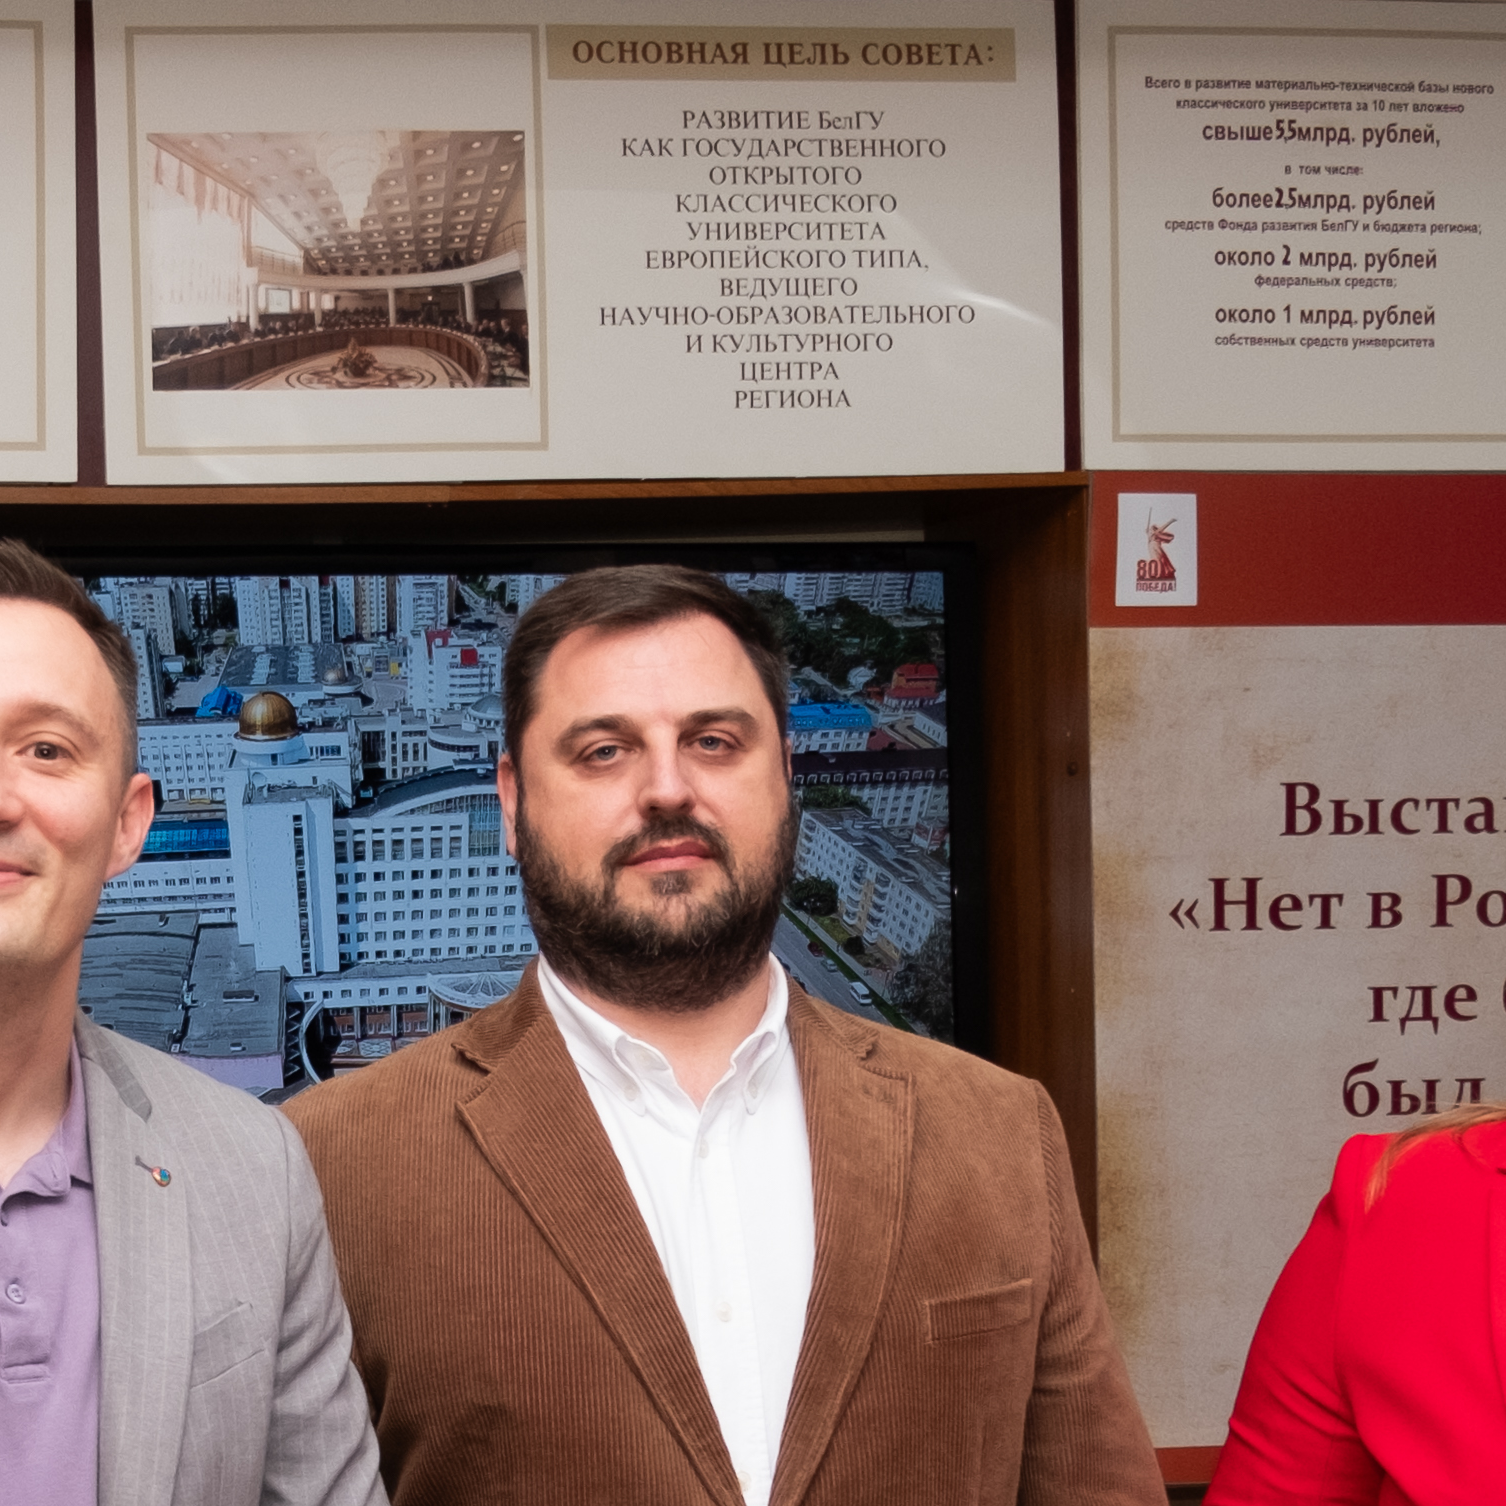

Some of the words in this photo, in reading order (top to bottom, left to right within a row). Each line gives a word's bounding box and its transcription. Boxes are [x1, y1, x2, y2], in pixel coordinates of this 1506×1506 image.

[572, 39, 749, 66] ОСНОВНАЯ
[763, 42, 850, 68] ЦЕЛЬ
[861, 42, 995, 67] СОВЕТА:
[1144, 76, 1181, 90] Всего
[1184, 80, 1191, 89] в
[1195, 79, 1251, 92] развитие
[1255, 79, 1416, 95] материально-технической
[1418, 81, 1449, 94] базы
[1452, 84, 1494, 95] нового
[1176, 99, 1266, 111] классического
[1269, 100, 1352, 114] университета
[1355, 102, 1368, 112] за
[1372, 100, 1385, 112] 10
[1389, 103, 1409, 114] лет
[1412, 103, 1465, 114] вложено
[682, 110, 811, 131] РАЗВИТИЕ
[818, 110, 885, 131] БелГУ
[1362, 122, 1441, 148] рублей,
[621, 138, 674, 158] КАК
[681, 139, 946, 162] ГОСУДАРСТВЕННОГО
[709, 166, 862, 186] ОТКРЫТОГО
[1284, 165, 1292, 175] в
[1299, 165, 1321, 175] том
[1324, 165, 1364, 177] числе:
[675, 194, 897, 214] КЛАССИЧЕСКОГО
[1362, 190, 1436, 215] рублей
[687, 221, 886, 242] УНИВЕРСИТЕТА
[1164, 219, 1214, 233] средств
[1218, 218, 1258, 233] Фонда
[1261, 220, 1317, 235] развития
[1321, 219, 1359, 233] БелГУ
[1362, 223, 1370, 232] и
[1373, 220, 1426, 235] бюджета
[1430, 223, 1482, 236] региона;
[645, 245, 845, 270] ЕВРОПЕЙСКОГО
[852, 250, 929, 272] ТИПА,
[1214, 250, 1275, 267] около
[1281, 244, 1291, 267] 2
[1299, 250, 1358, 270] млрд.
[1364, 248, 1437, 272] рублей
[719, 277, 858, 299] ВЕДУЩЕГО
[599, 305, 975, 326] НАУЧНО-ОБРАЗОВАТЕЛЬНОГО
[1215, 307, 1275, 324] около
[1282, 305, 1292, 324] 1
[1300, 307, 1358, 327] млрд.
[1362, 304, 1436, 329] рублей
[685, 334, 703, 354] И
[711, 334, 893, 354] КУЛЬТУРНОГО
[1215, 334, 1296, 347] собственных
[1300, 336, 1349, 348] средств
[1351, 336, 1435, 349] университета
[740, 361, 839, 384] ЦЕНТРА
[734, 389, 852, 409] РЕГИОНА
[1137, 560, 1159, 579] 80
[1169, 877, 1344, 932] «Нет
[1366, 891, 1403, 929] в
[1367, 983, 1478, 1036] где
